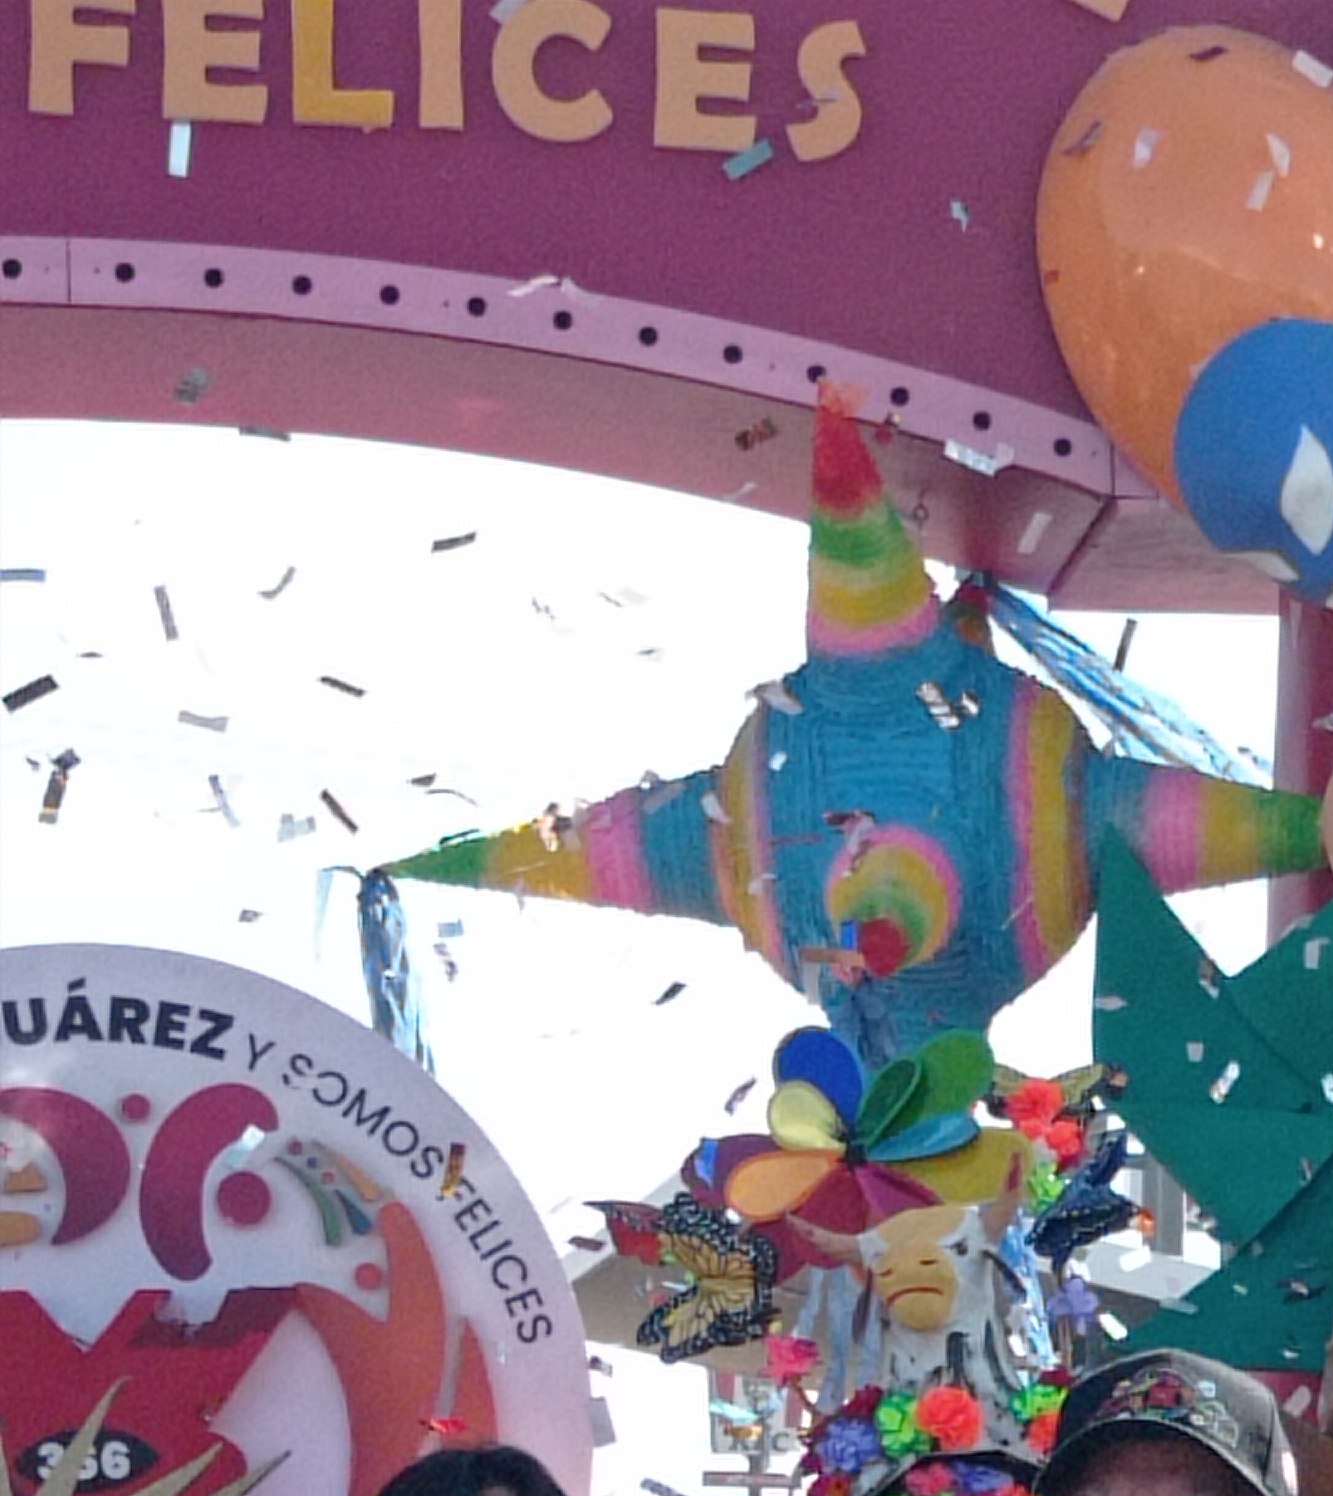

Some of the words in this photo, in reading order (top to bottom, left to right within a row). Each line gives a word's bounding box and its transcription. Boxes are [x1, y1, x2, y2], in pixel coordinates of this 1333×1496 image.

[28, 0, 867, 163] FELICES
[247, 1033, 276, 1072] Y
[281, 1053, 444, 1179] SOMOS
[436, 1175, 553, 1344] FELICES
